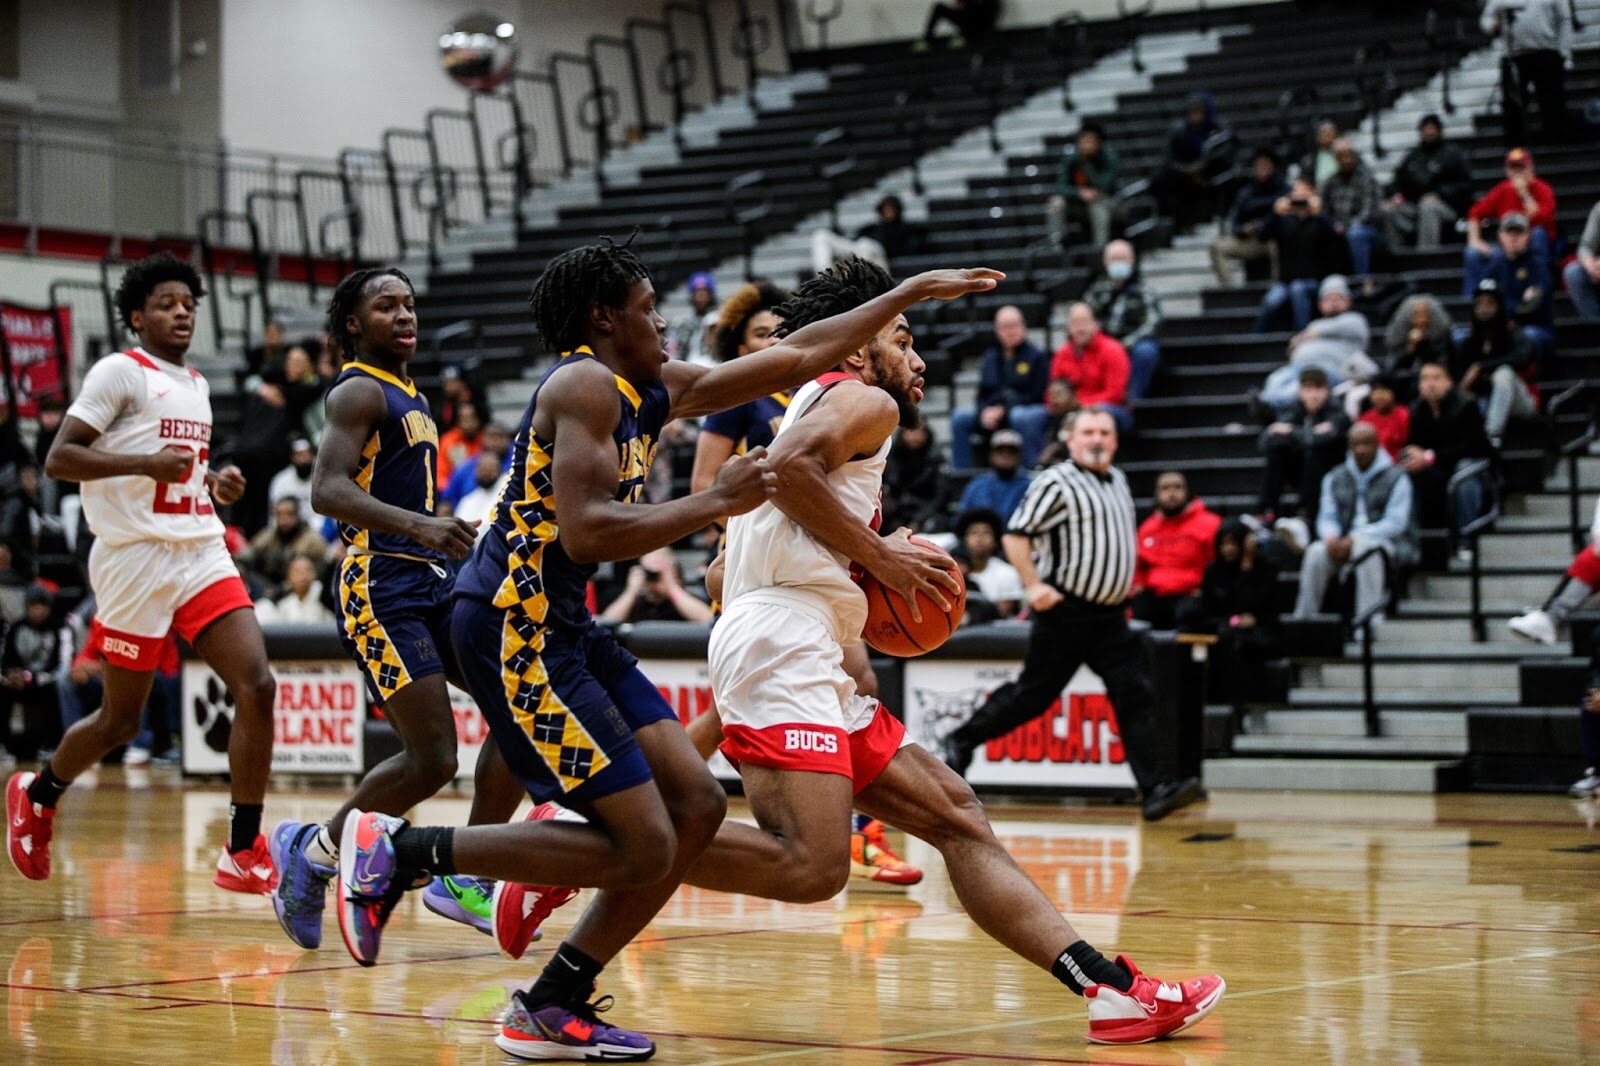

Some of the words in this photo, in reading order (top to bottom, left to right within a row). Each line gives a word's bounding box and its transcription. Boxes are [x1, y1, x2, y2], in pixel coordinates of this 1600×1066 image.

[424, 448, 434, 512] 1
[103, 635, 140, 660] BUCS
[276, 682, 355, 711] RAND
[784, 728, 839, 754] BUCS
